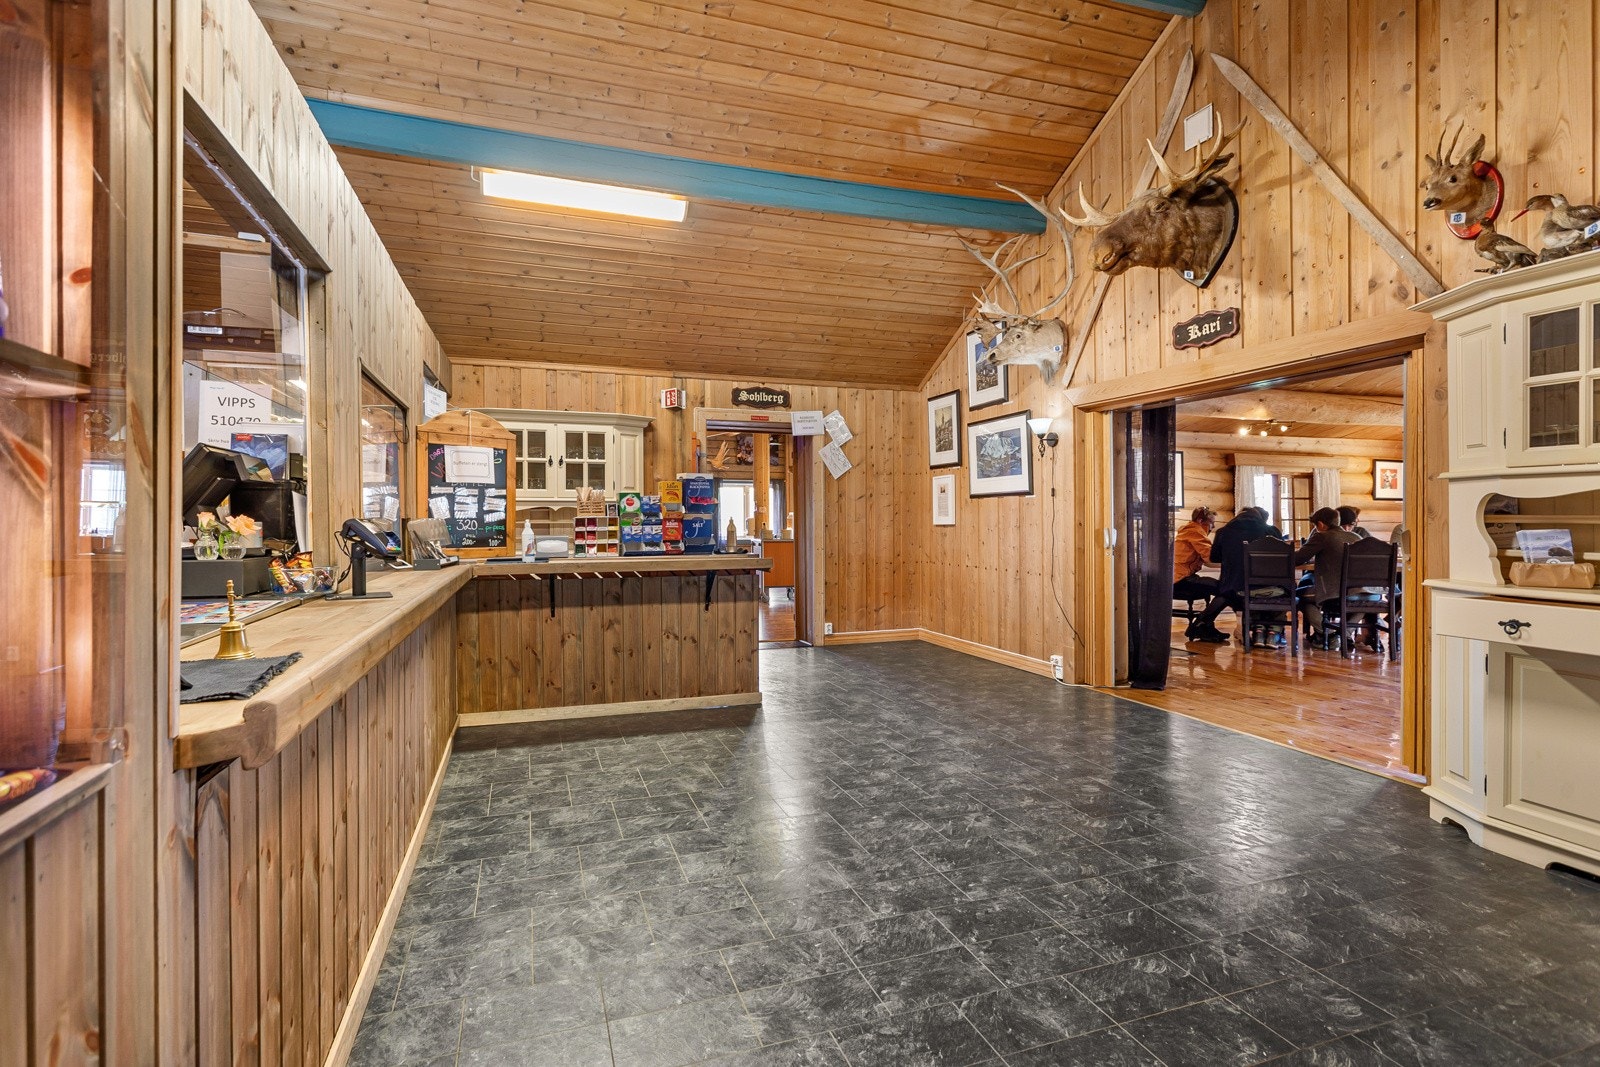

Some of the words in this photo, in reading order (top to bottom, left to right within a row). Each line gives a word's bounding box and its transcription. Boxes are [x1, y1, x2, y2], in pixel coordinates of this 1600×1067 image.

[1187, 316, 1221, 342] Kari
[217, 396, 255, 408] VIPPS
[738, 390, 784, 404] Sohlberg
